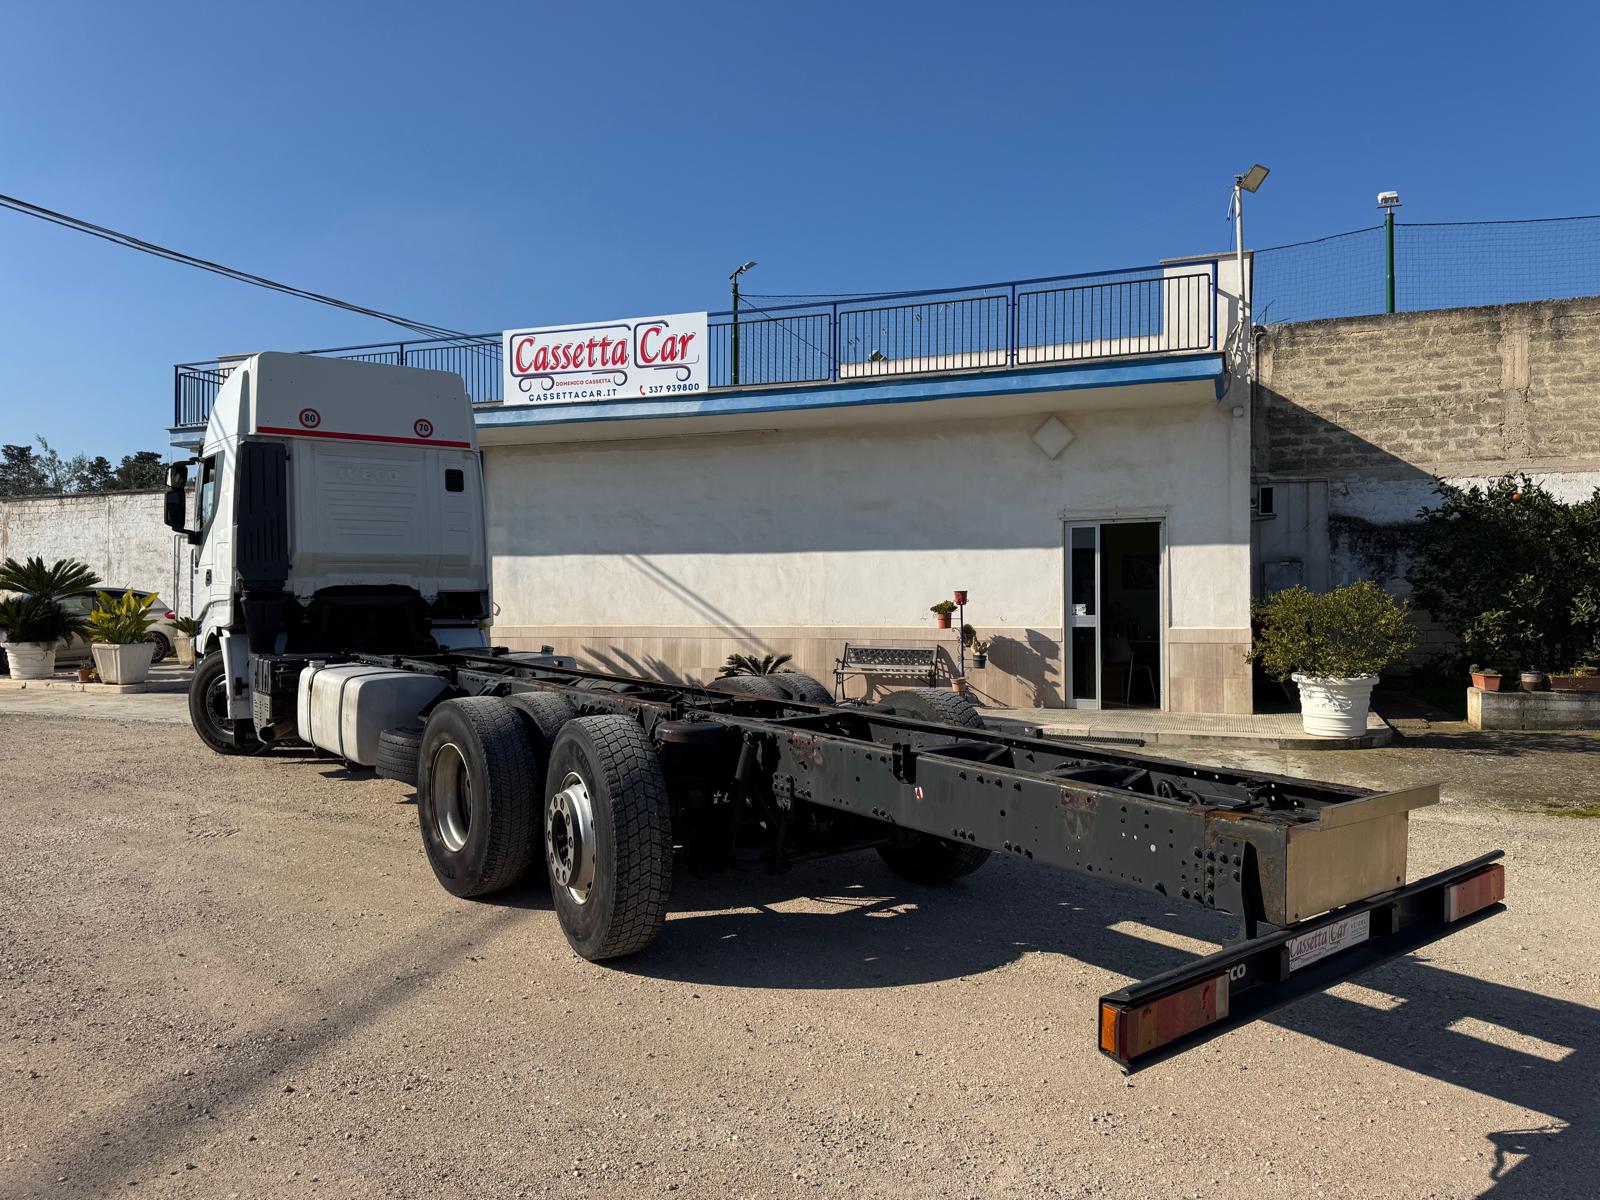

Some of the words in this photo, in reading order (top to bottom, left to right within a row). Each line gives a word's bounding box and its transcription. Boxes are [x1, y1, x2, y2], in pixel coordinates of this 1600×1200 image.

[515, 335, 630, 373] Cassetta
[640, 325, 697, 364] Car
[648, 385, 664, 394] 337
[666, 383, 700, 393] 939800
[528, 388, 617, 402] CASSETTACAR.IT
[304, 413, 316, 422] 80
[419, 423, 429, 432] 70
[337, 468, 399, 481] IVECO
